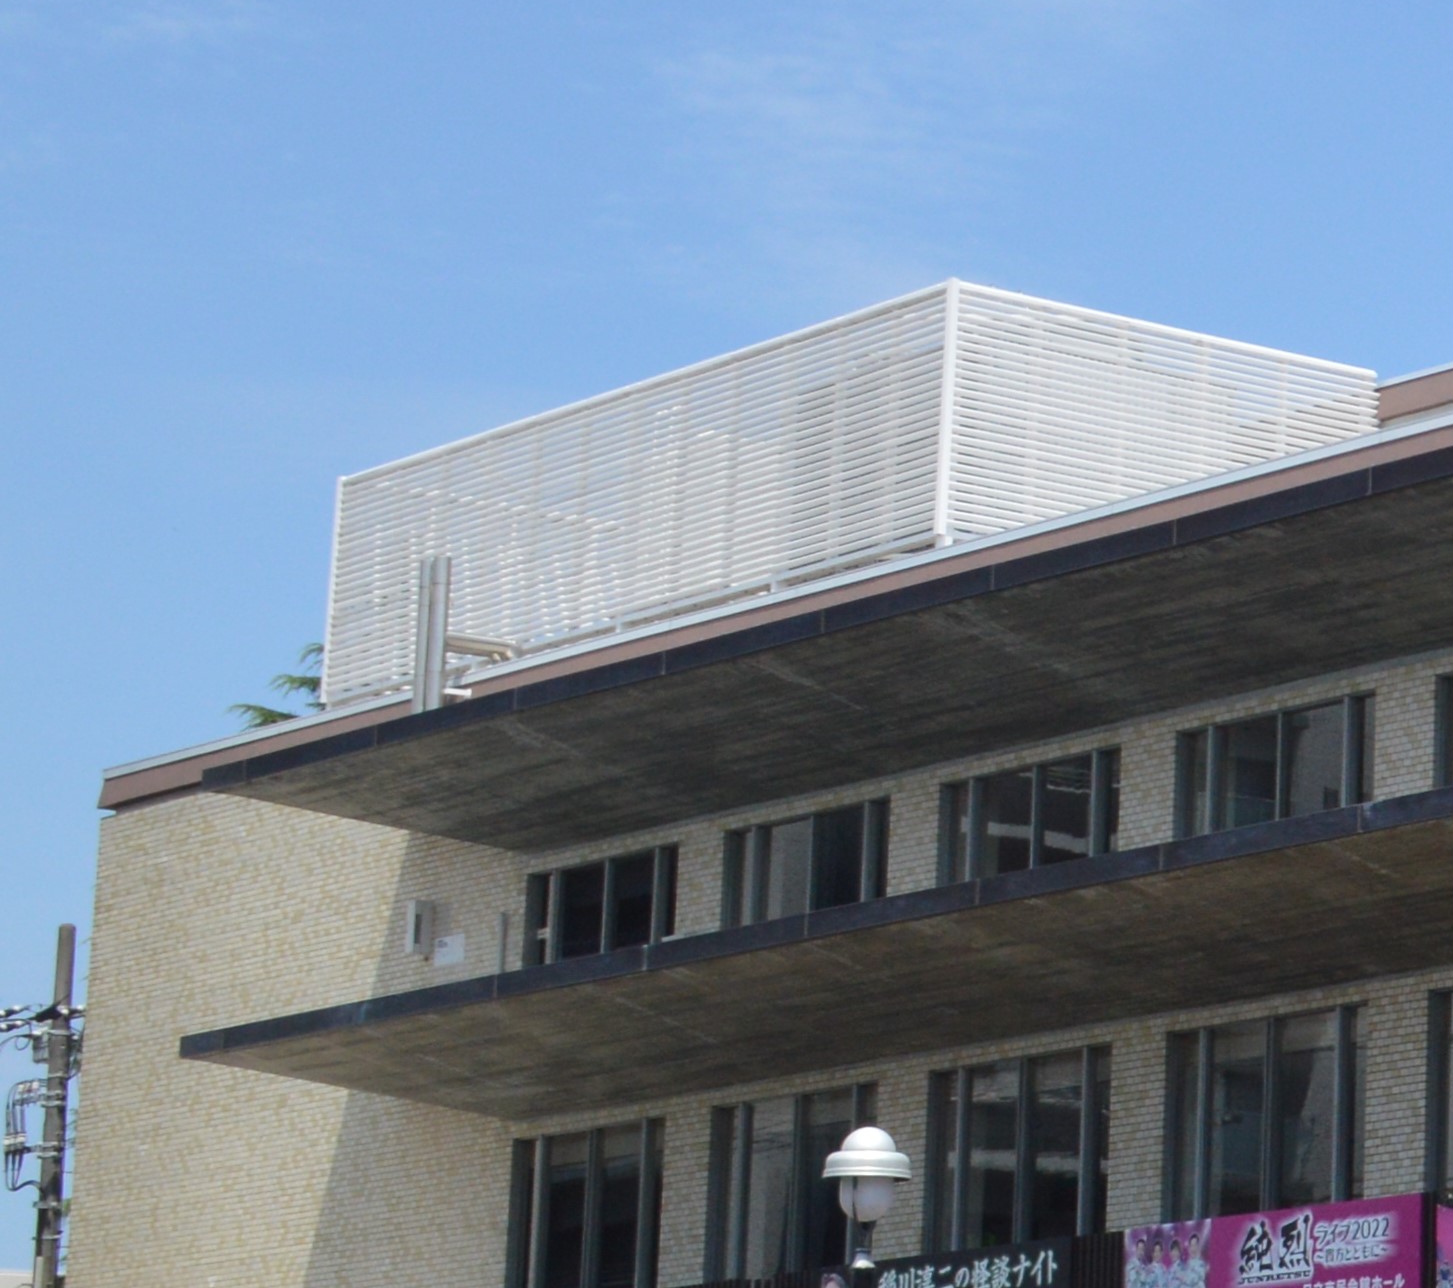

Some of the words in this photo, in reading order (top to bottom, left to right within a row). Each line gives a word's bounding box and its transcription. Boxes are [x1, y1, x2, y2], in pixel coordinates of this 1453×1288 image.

[1239, 1213, 1312, 1275] 純烈
[1314, 1217, 1390, 1245] ライブ2022
[1238, 1269, 1311, 1286] JUNRETSU
